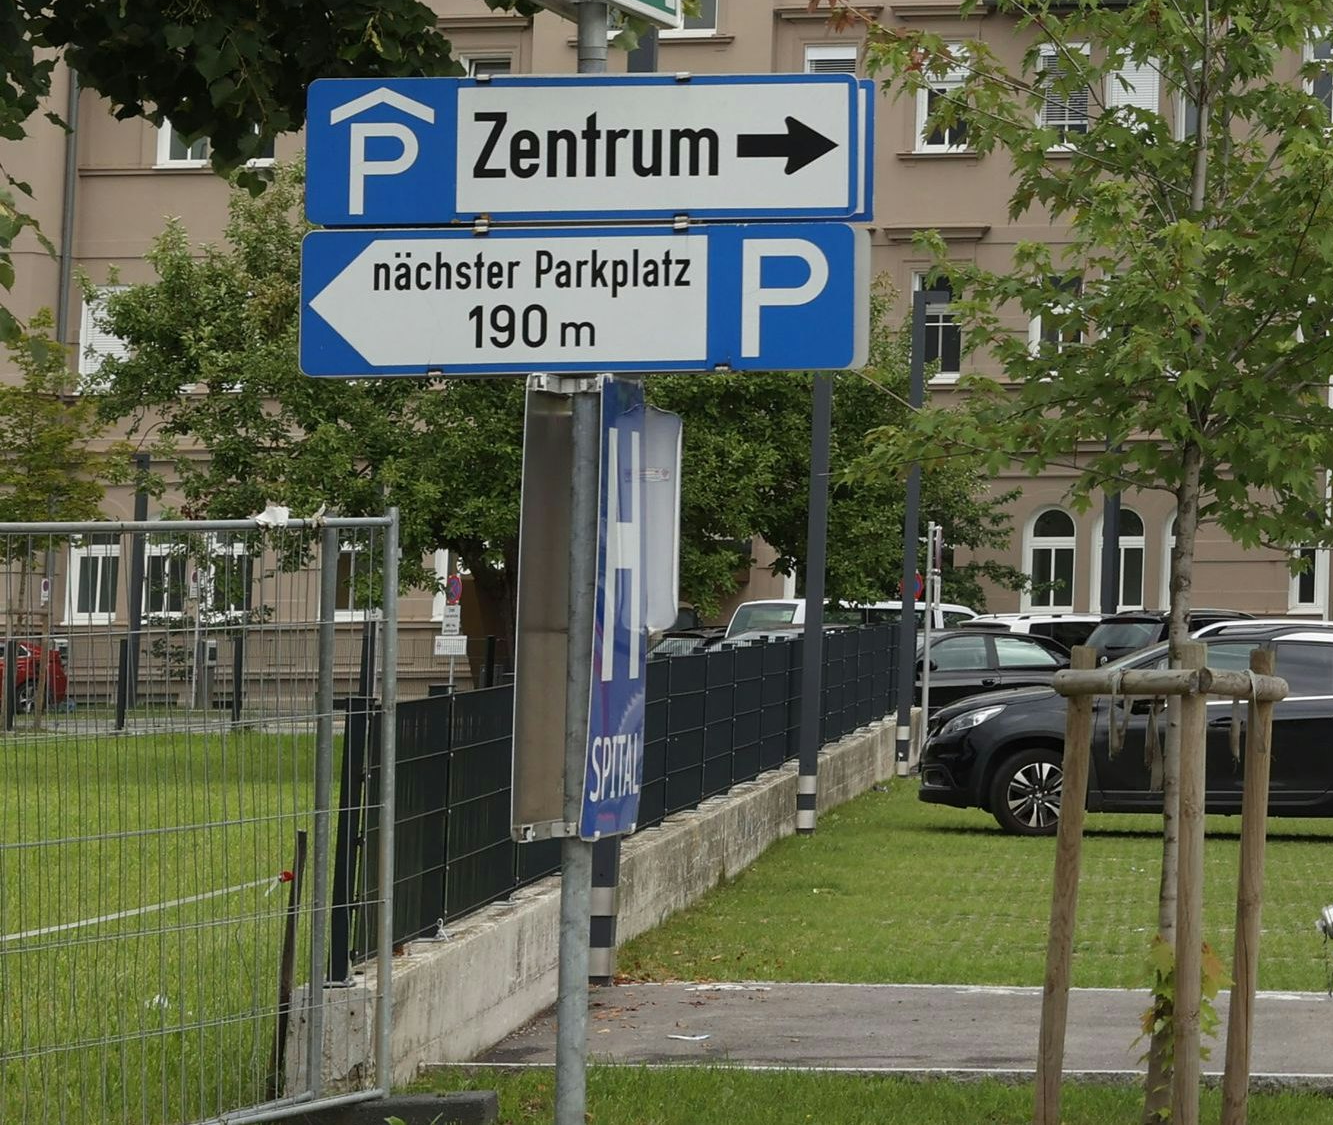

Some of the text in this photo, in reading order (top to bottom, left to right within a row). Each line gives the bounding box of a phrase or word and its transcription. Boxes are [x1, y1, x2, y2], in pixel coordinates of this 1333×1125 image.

[349, 111, 720, 215] P Zentrum
[373, 249, 692, 298] nächster Parkplatz
[741, 238, 830, 357] P
[468, 304, 597, 349] 190 m
[601, 427, 640, 682] H
[588, 733, 640, 803] SPITAL
